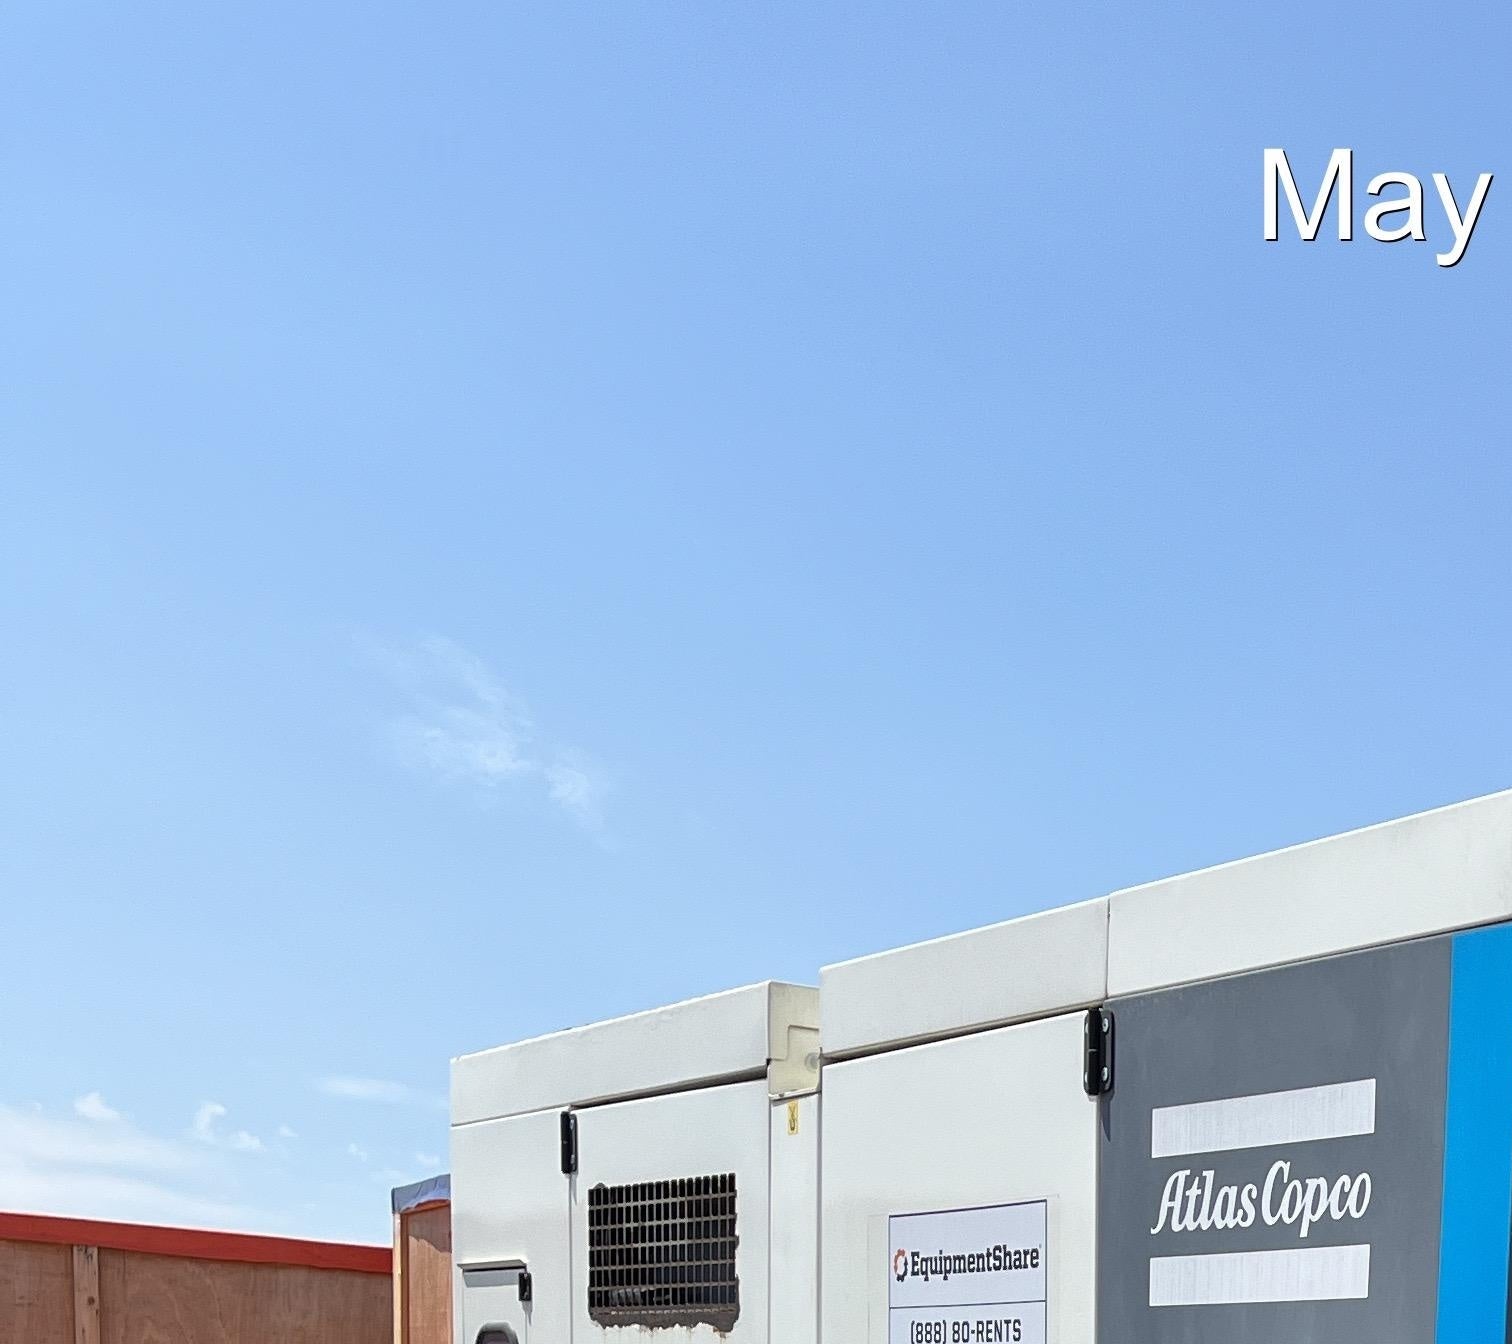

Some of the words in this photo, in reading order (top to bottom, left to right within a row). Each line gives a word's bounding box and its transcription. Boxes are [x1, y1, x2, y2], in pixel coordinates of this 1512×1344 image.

[1150, 1169, 1258, 1235] Atlas
[1261, 1159, 1372, 1238] Copco
[910, 1243, 1040, 1282] EquipmentShare
[952, 1318, 1022, 1344] 80-RENTS
